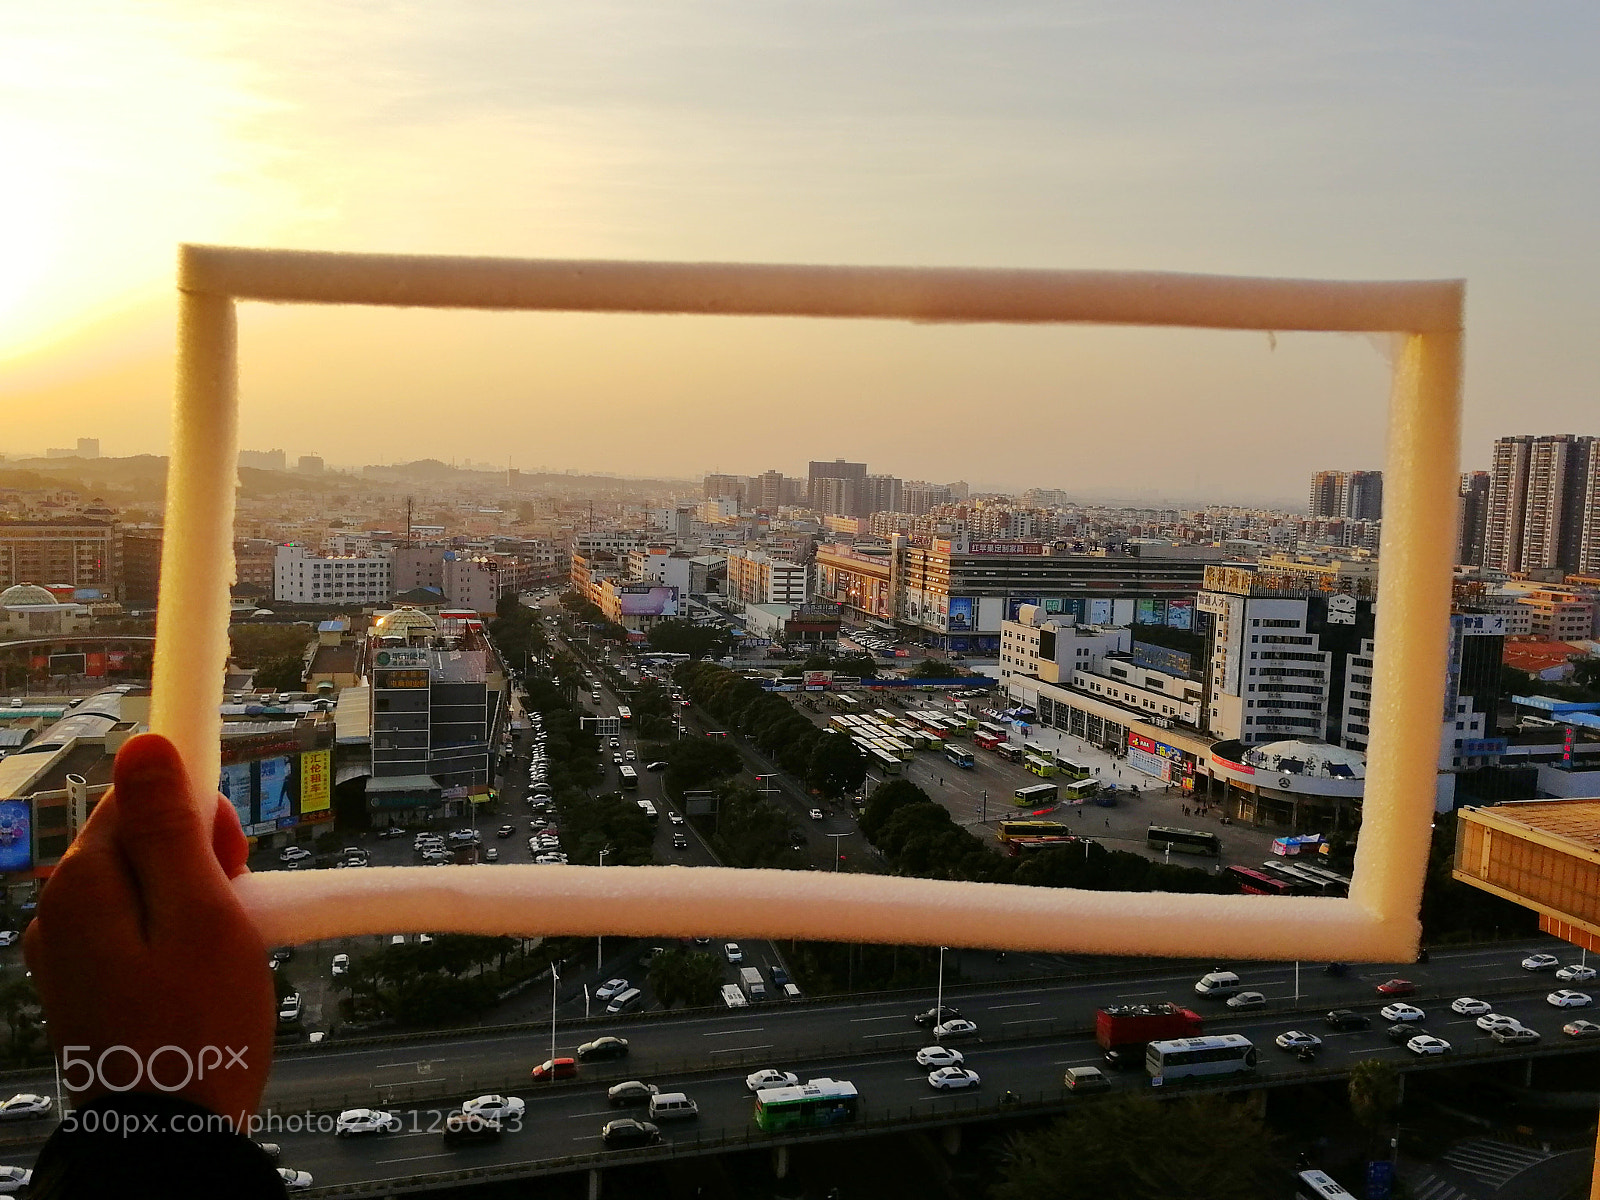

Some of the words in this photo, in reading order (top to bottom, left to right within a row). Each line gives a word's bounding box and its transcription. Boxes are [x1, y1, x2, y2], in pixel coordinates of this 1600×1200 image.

[971, 544, 1024, 553] 红苹果定制家具
[310, 754, 322, 793] 汇伦租车
